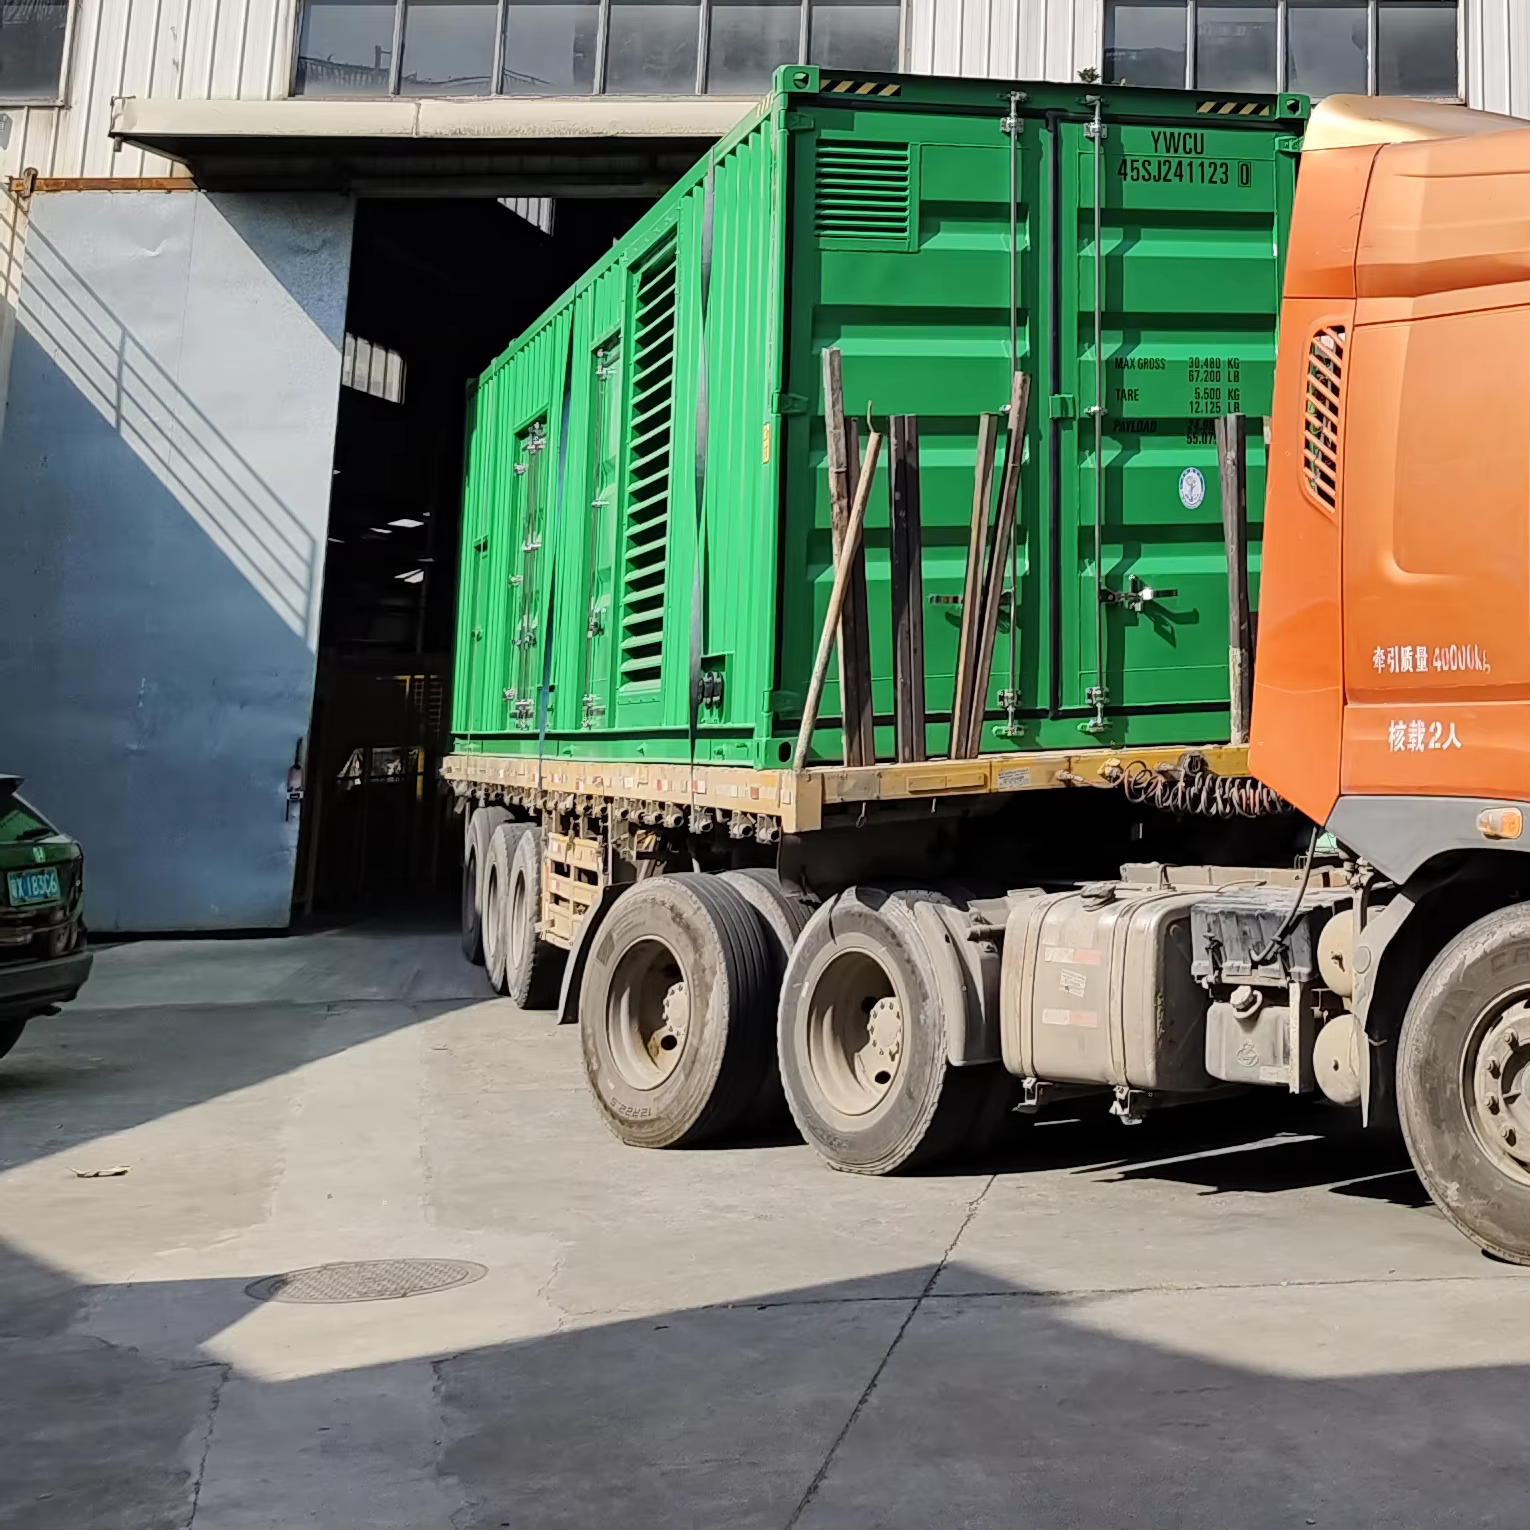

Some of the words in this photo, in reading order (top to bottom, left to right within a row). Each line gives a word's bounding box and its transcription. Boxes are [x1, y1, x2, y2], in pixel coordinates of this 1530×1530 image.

[1150, 130, 1205, 155] YWCU
[1117, 158, 1229, 185] 45SJ241123
[1115, 357, 1136, 370] MAX
[1137, 357, 1167, 370] GROSS
[1227, 357, 1241, 370] KG
[1227, 371, 1241, 383] LB
[1115, 388, 1140, 401] TARE
[1227, 388, 1241, 401] KG
[1189, 401, 1222, 414] 12.125
[1227, 402, 1241, 413] LB
[1113, 420, 1157, 433] PAYLOAD
